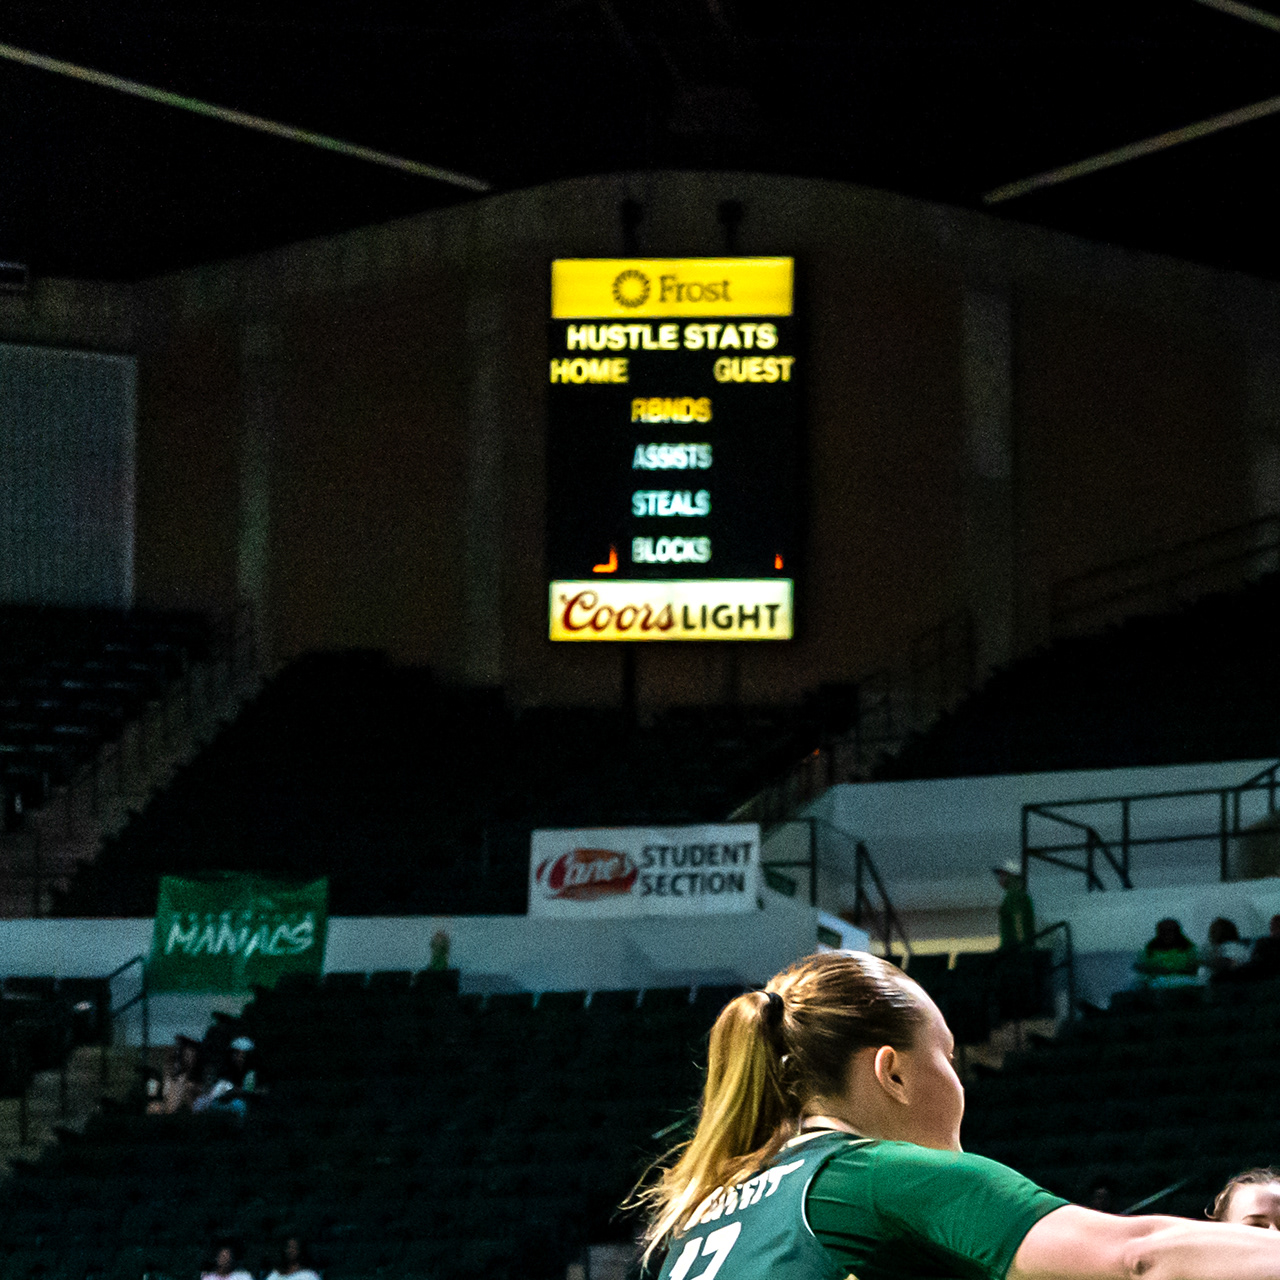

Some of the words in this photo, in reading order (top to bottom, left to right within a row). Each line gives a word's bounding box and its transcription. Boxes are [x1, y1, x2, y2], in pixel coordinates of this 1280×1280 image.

[658, 274, 731, 303] Frost
[567, 324, 679, 350] HUSTLE
[684, 323, 777, 349] STATS
[550, 358, 629, 384] HOME
[714, 356, 795, 382] GUEST
[631, 398, 712, 423] RBNDS
[632, 443, 713, 470] ASSISTS
[632, 490, 711, 517] STEALS
[632, 537, 711, 563] BLOCKS
[559, 590, 675, 632] Coors
[683, 603, 781, 630] LIGHT
[640, 843, 753, 868] STUDENT
[639, 872, 746, 896] SECTION
